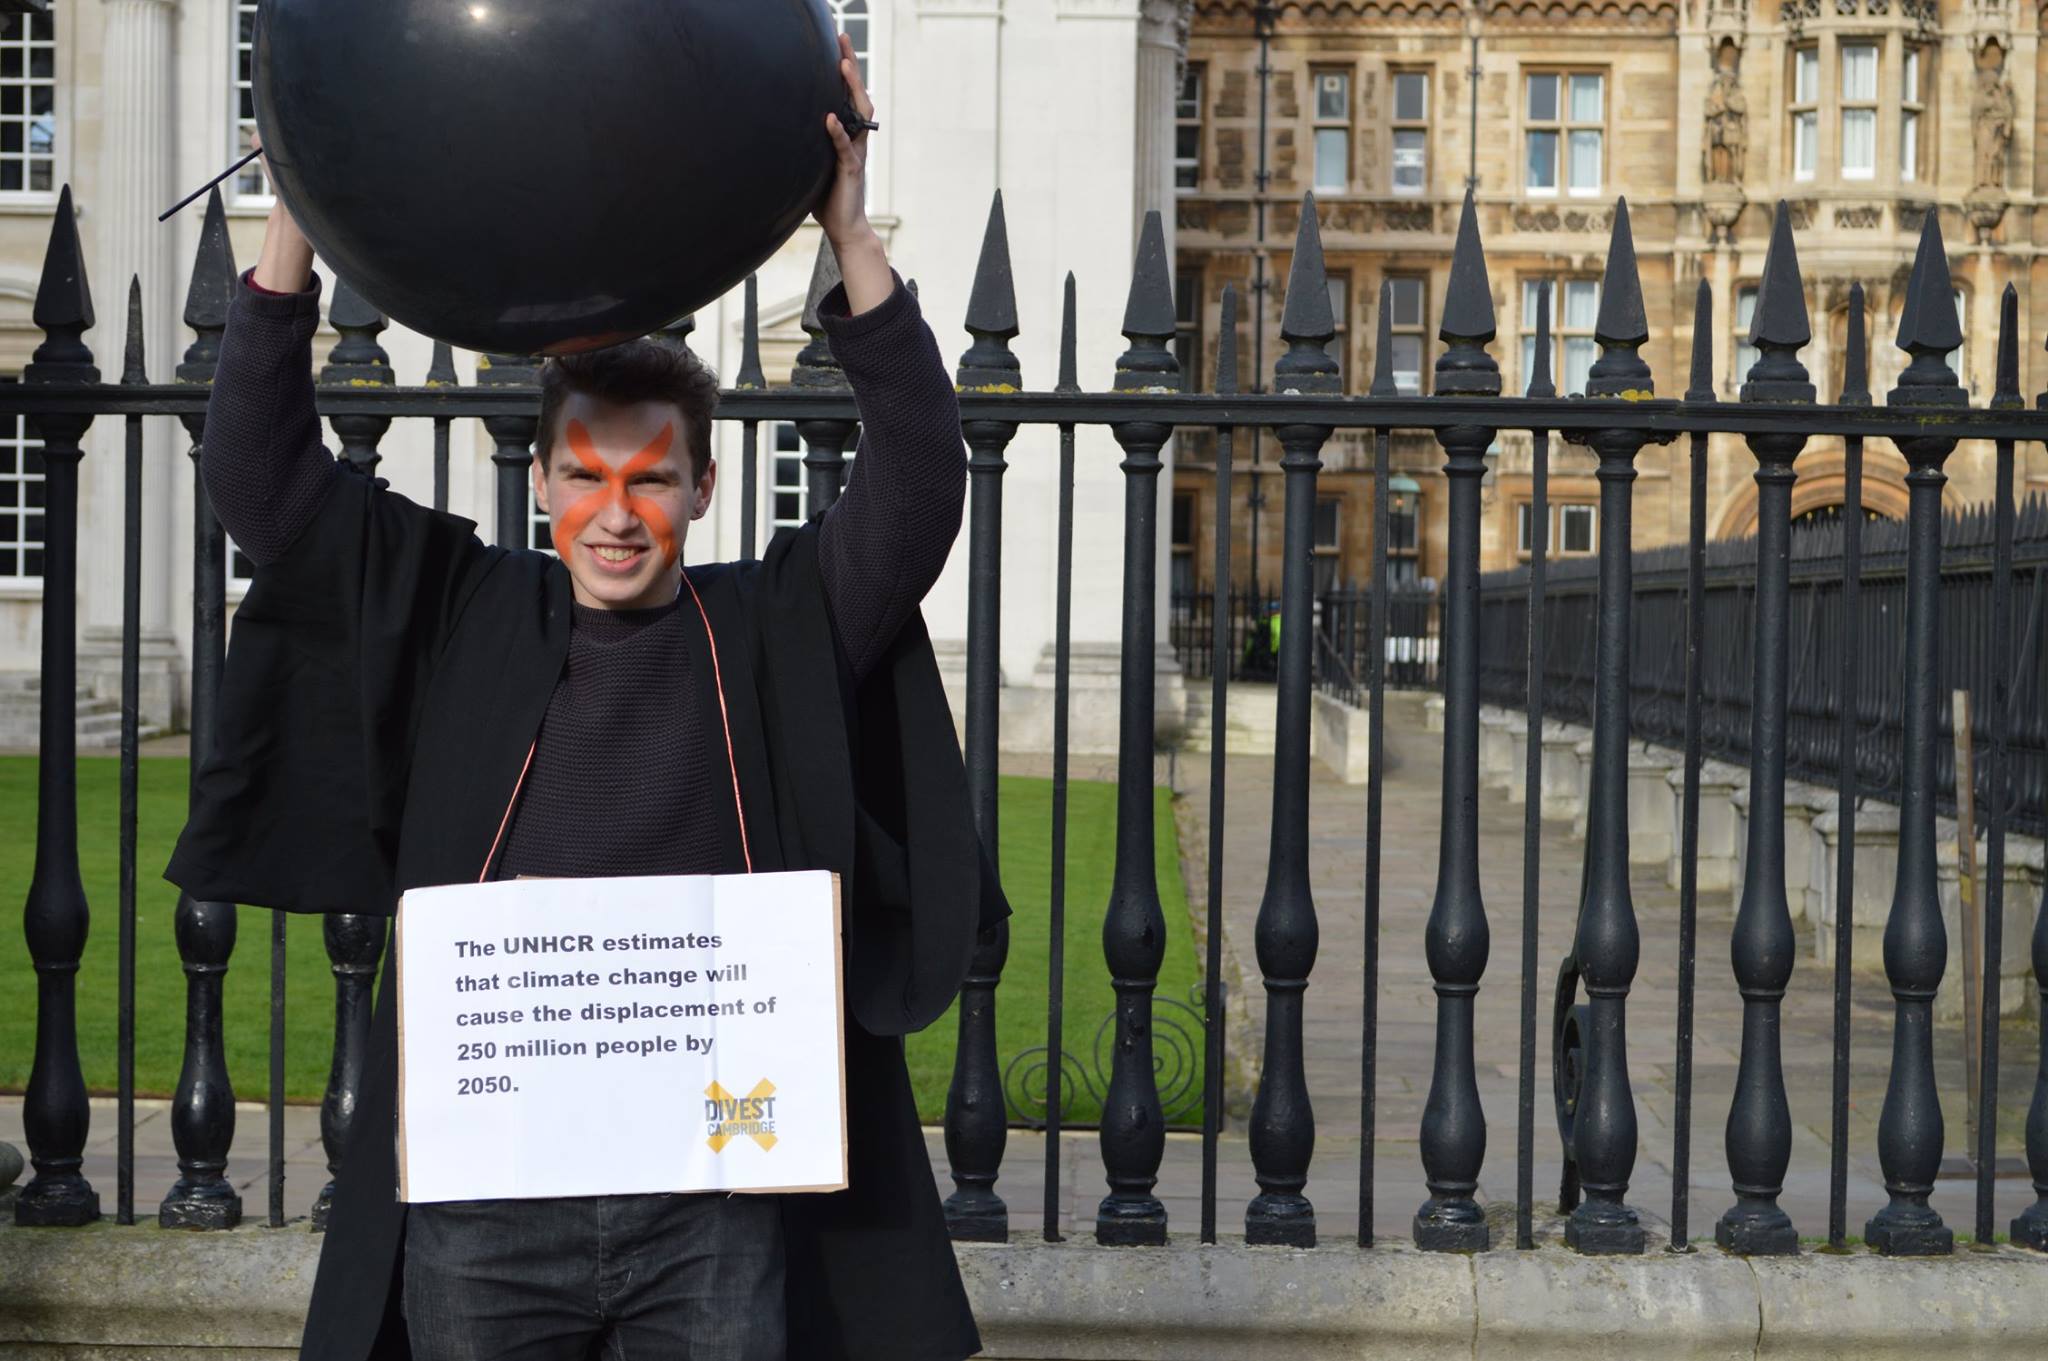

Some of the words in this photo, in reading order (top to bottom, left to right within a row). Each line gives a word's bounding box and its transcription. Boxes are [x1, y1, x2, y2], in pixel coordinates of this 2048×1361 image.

[454, 940, 496, 958] The
[503, 935, 594, 954] UNHCR
[602, 932, 723, 951] estimates
[455, 974, 500, 993] that
[507, 970, 600, 989] climate
[608, 968, 698, 988] change
[706, 964, 748, 983] will
[456, 1010, 524, 1027] cause
[532, 1005, 572, 1022] the
[580, 999, 745, 1024] displacement
[753, 996, 777, 1014] of
[457, 1042, 497, 1061] 250
[505, 1039, 587, 1058] million
[595, 1035, 677, 1058] people
[686, 1034, 714, 1055] by
[457, 1075, 520, 1095] 2050.
[704, 1096, 776, 1122] DIVEST
[707, 1120, 776, 1137] CAMBRIDGE
